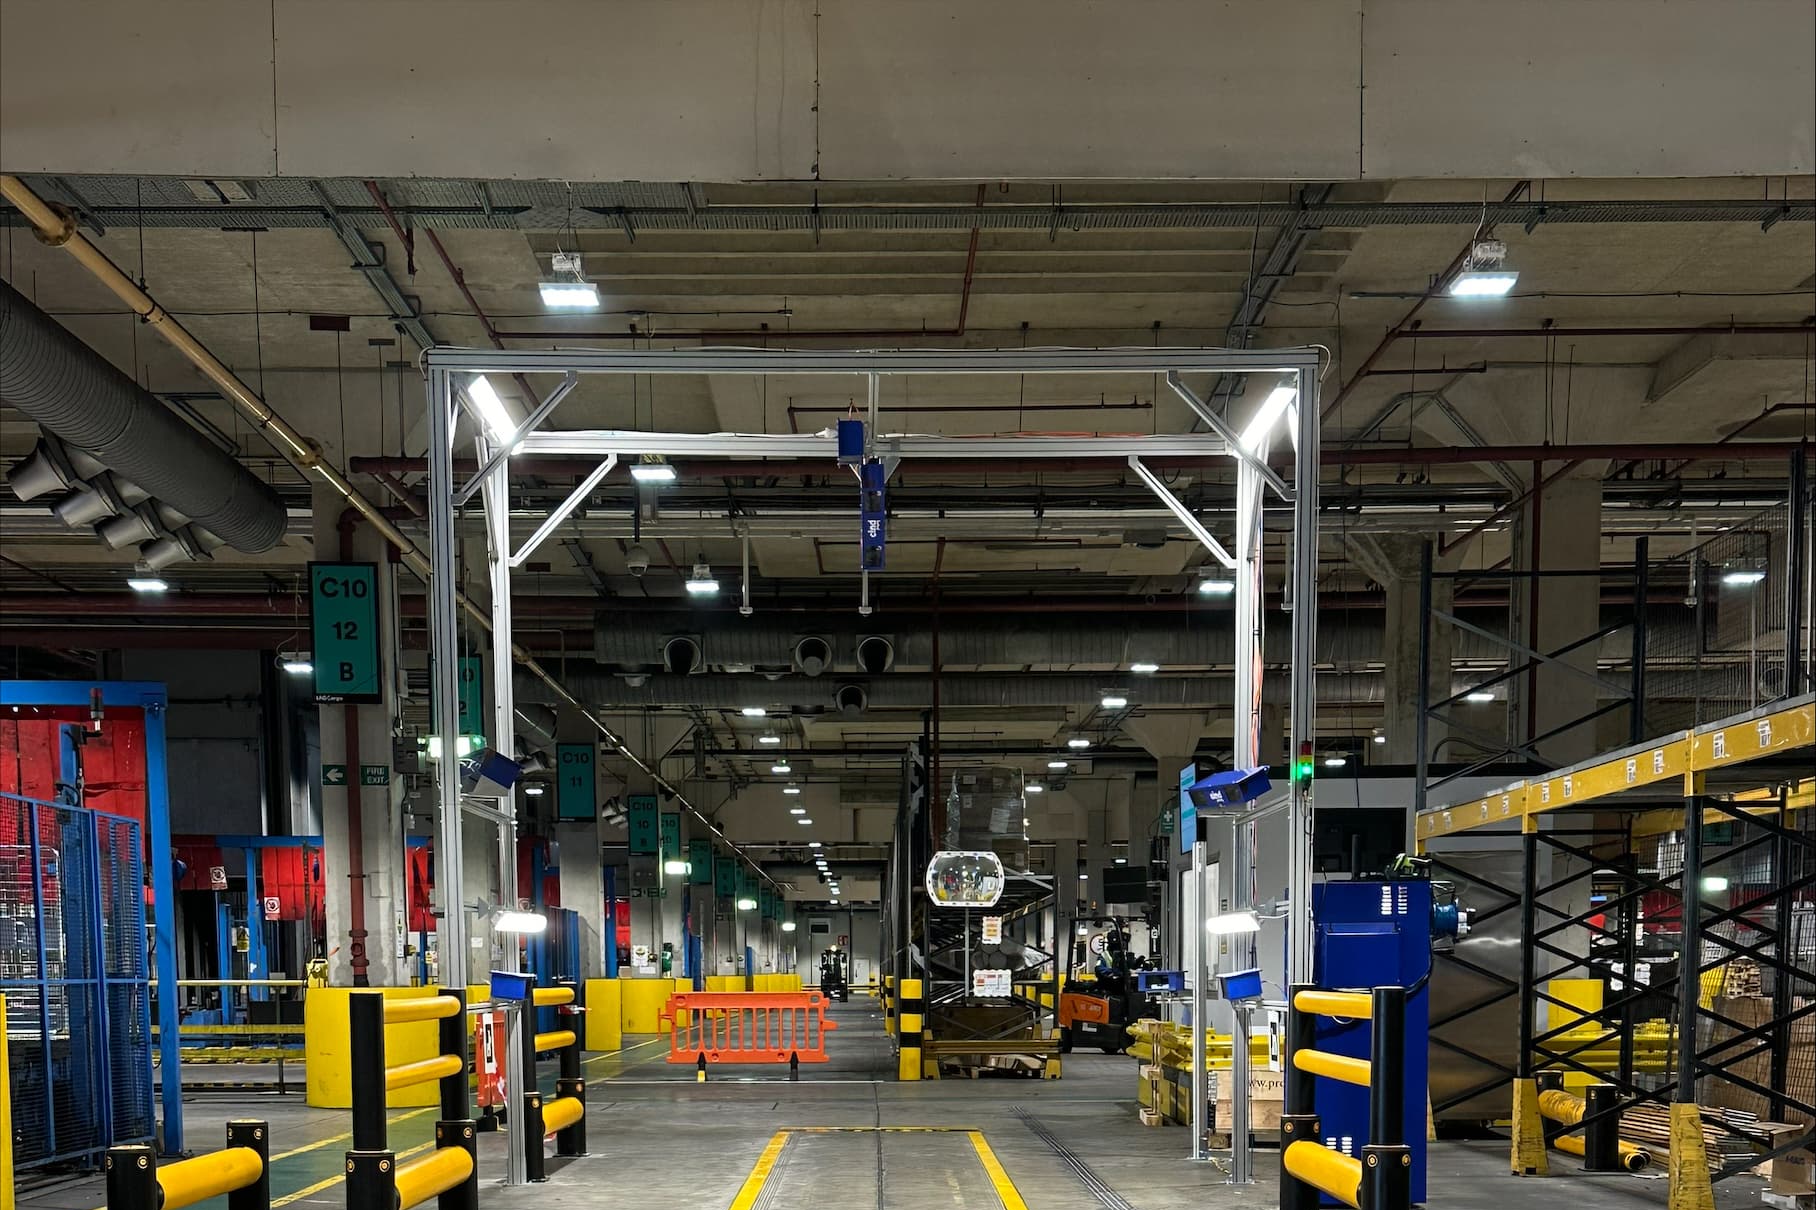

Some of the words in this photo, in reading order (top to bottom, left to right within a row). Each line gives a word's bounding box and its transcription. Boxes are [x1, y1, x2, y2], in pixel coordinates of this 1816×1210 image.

[319, 576, 368, 599] C10
[331, 621, 358, 641] 12
[338, 662, 355, 682] B
[562, 751, 589, 764] C10
[366, 775, 385, 784] EXIT
[570, 775, 583, 788] 11
